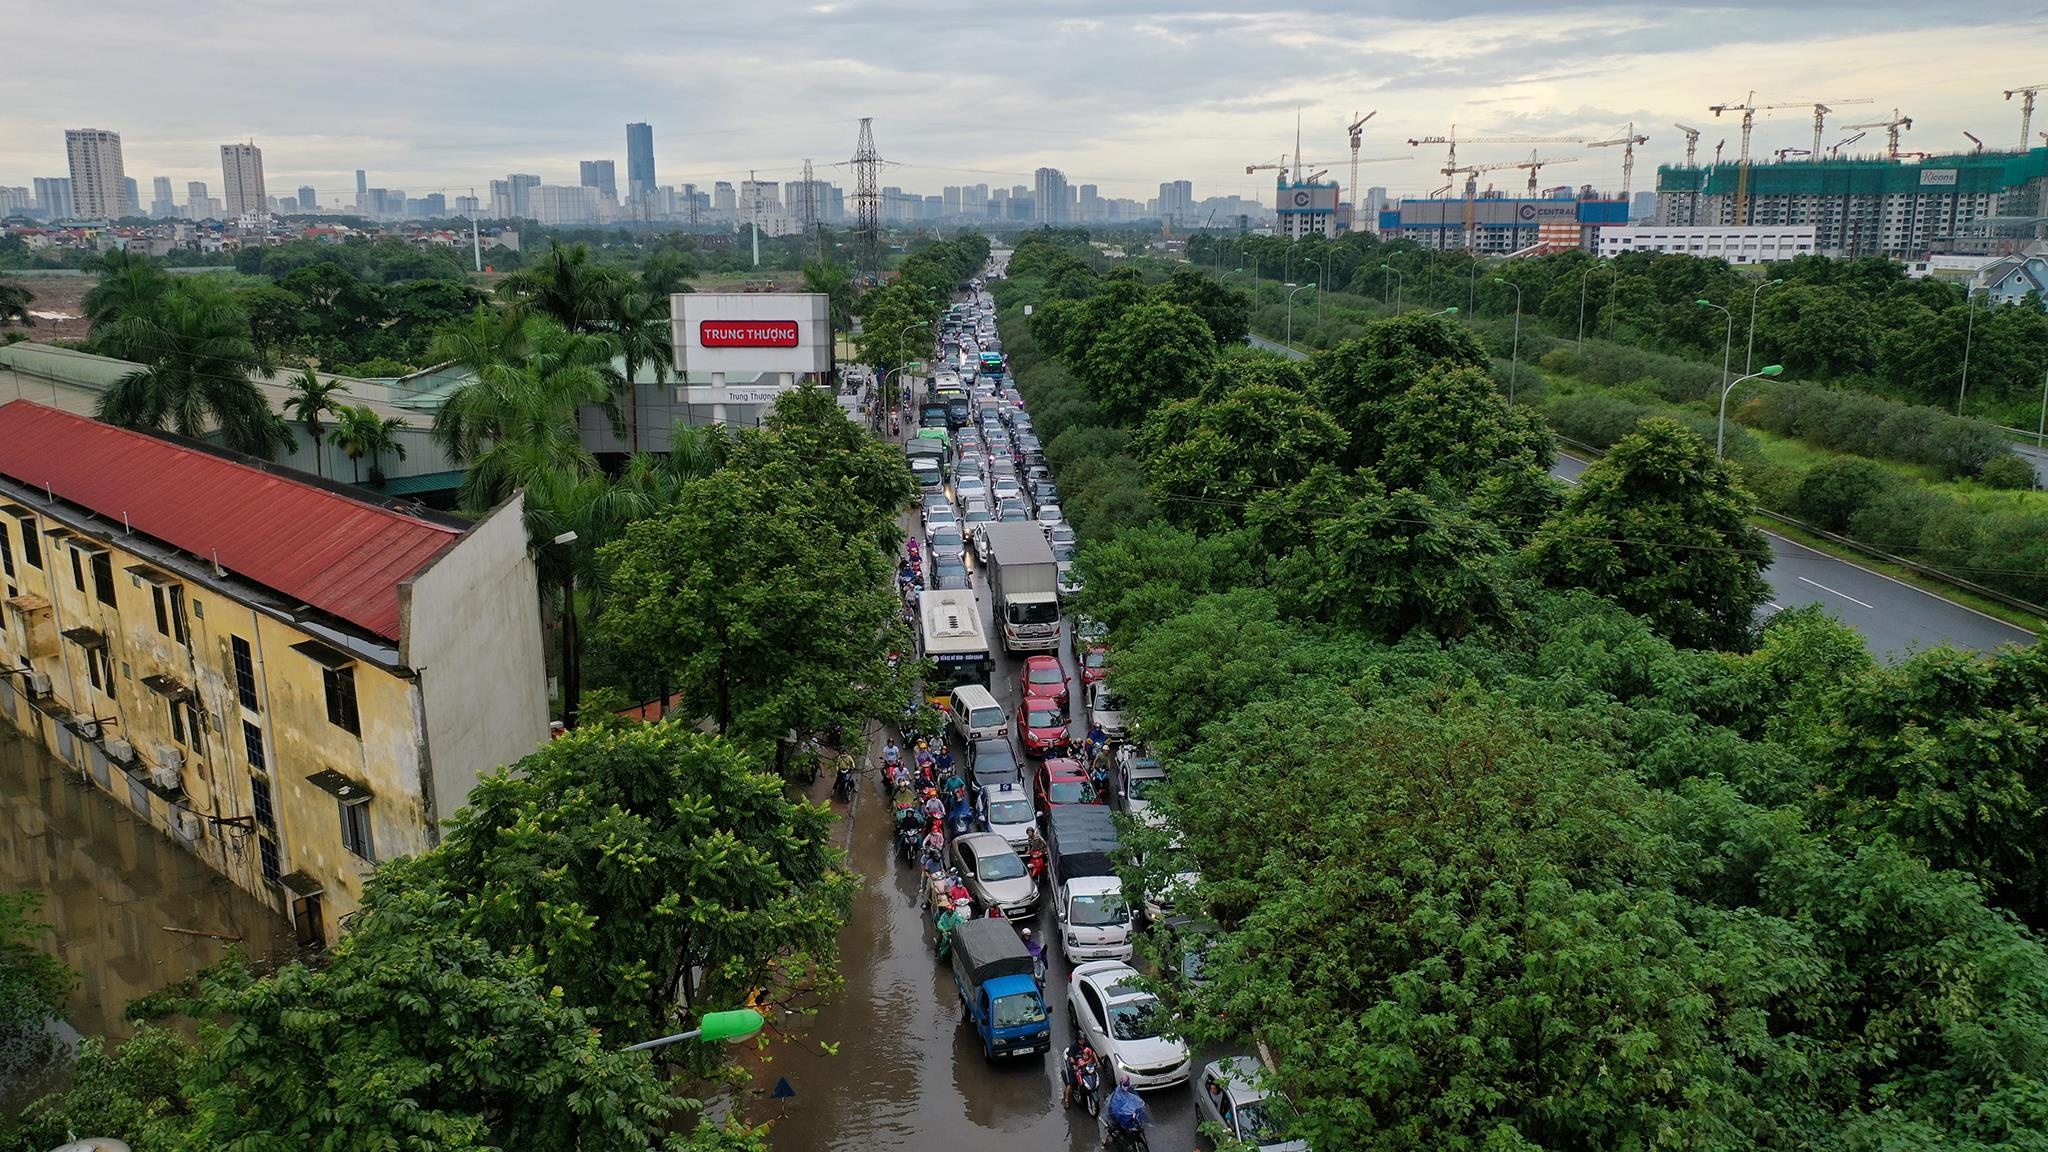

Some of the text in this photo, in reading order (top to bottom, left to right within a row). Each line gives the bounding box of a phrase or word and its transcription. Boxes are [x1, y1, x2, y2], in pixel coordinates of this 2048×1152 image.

[1923, 170, 1954, 182] Ricons
[1537, 208, 1576, 216] CENTRAL
[704, 328, 795, 342] TRUNG THƯỢNG
[729, 392, 749, 401] Trung
